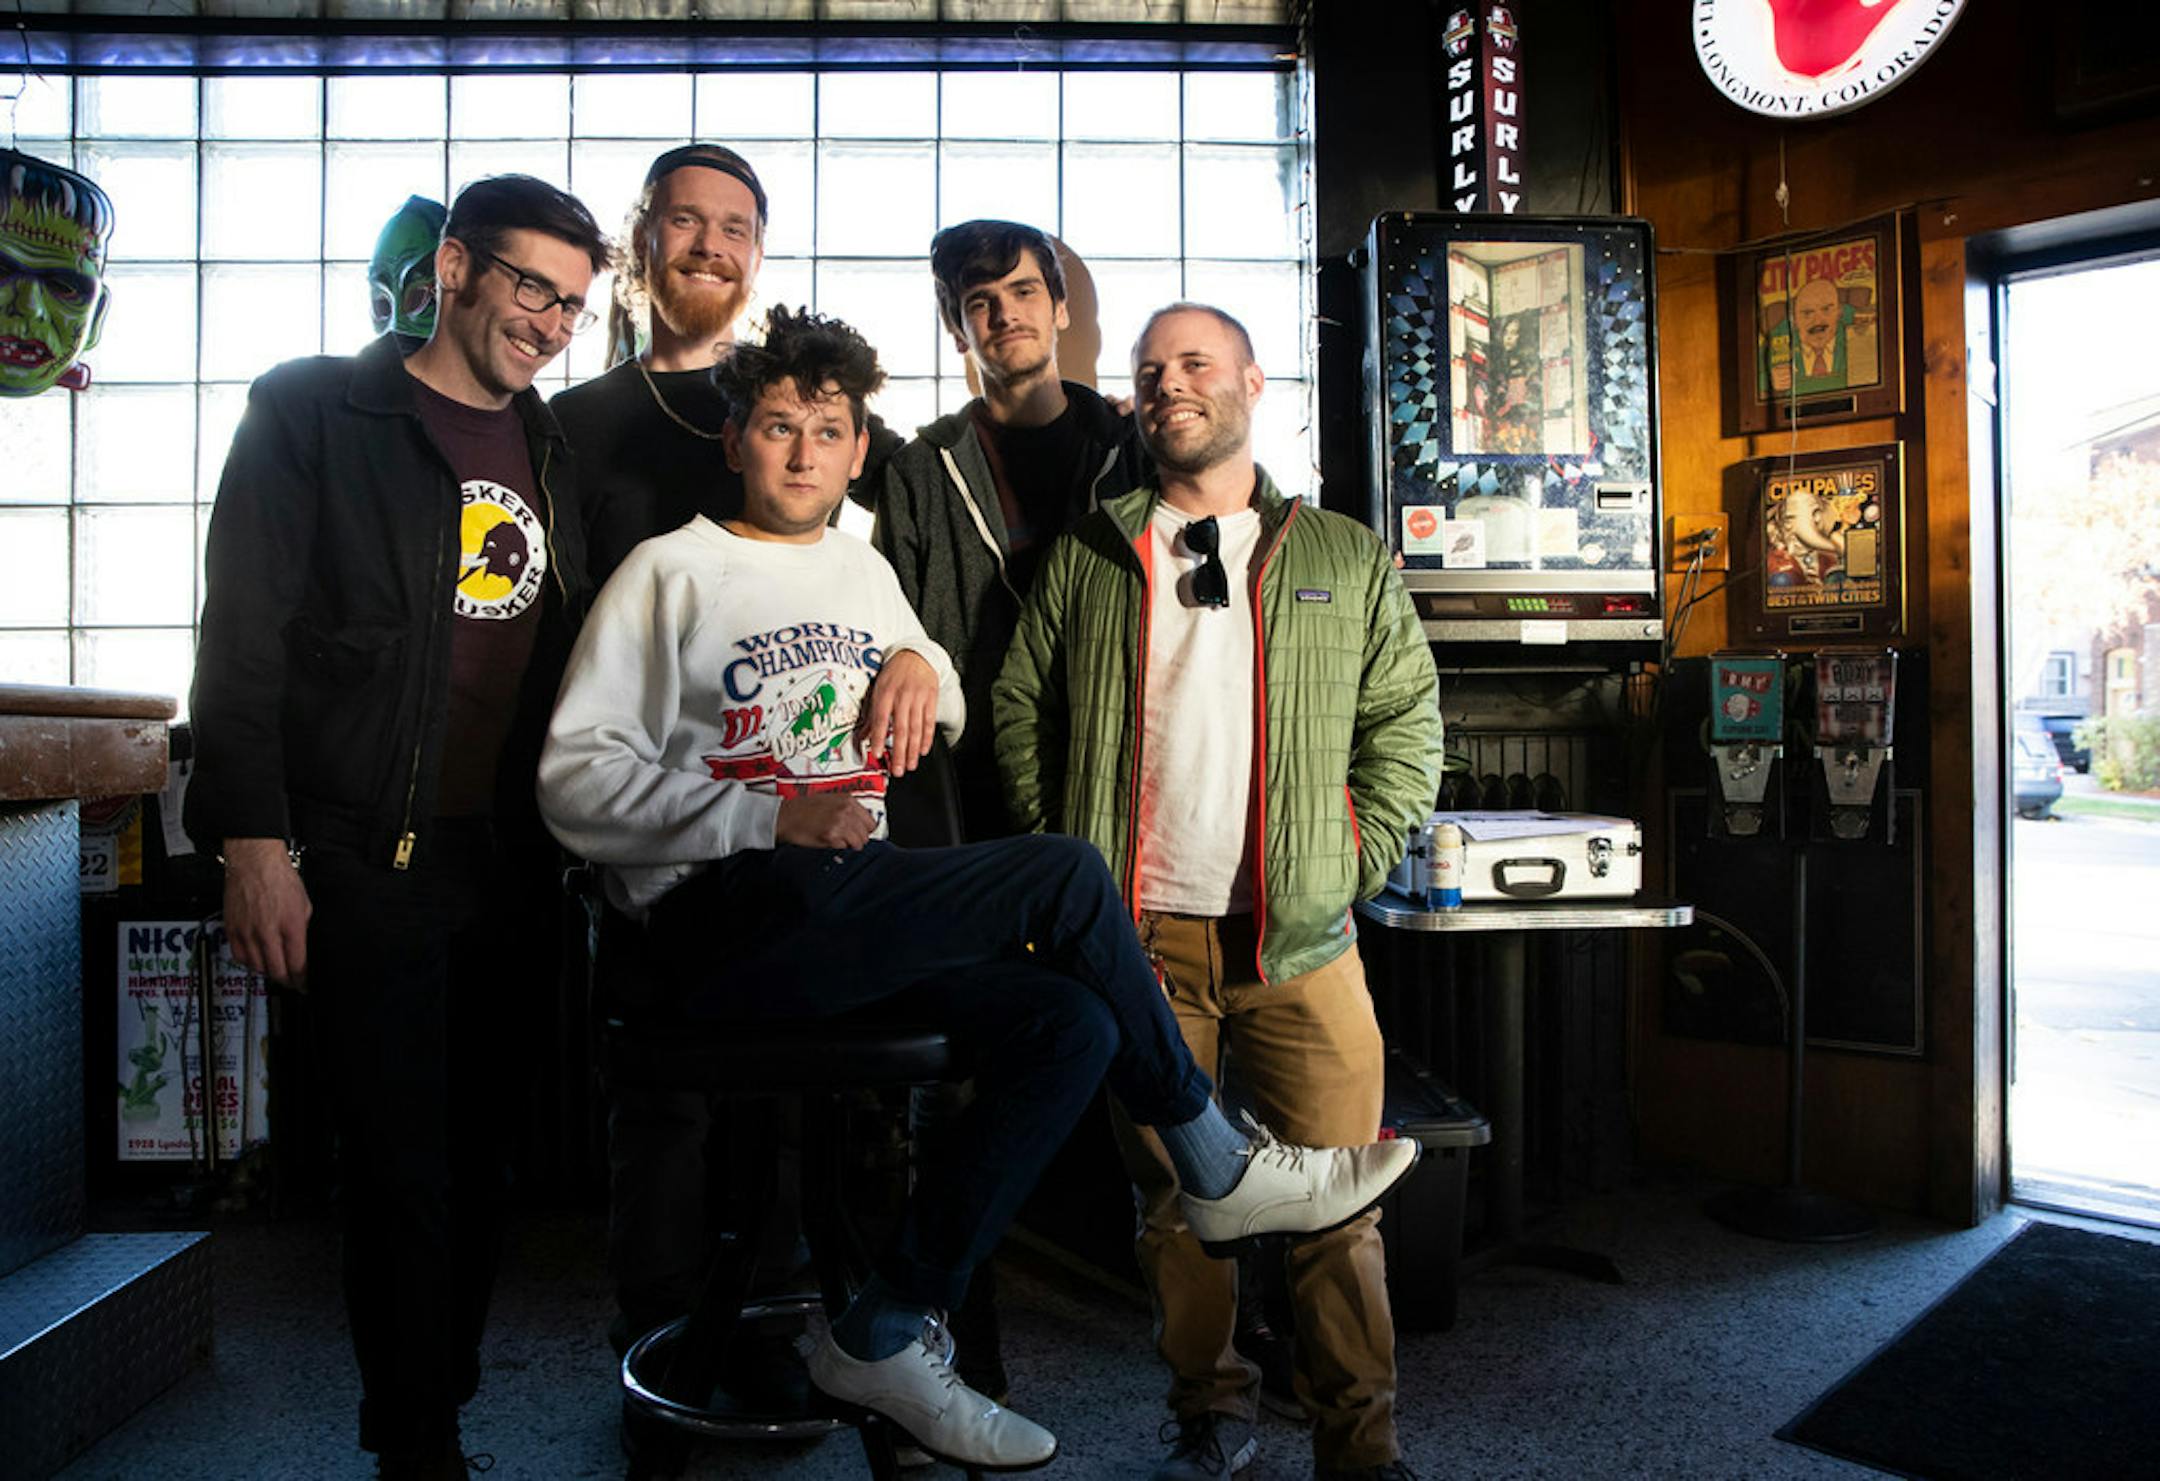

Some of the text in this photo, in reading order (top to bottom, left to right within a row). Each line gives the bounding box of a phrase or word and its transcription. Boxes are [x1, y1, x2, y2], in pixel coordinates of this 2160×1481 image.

[1822, 0, 1956, 109] COLORADO
[1447, 57, 1478, 214] SURLY
[1491, 55, 1521, 215] SURLY
[1762, 243, 1875, 294] CITY PAGES
[1813, 473, 1875, 496] PAES
[1807, 592, 1839, 605] TWIN
[1841, 590, 1881, 603] CITIES
[734, 622, 874, 652] WORLD
[722, 638, 886, 702] CHAMPIONS
